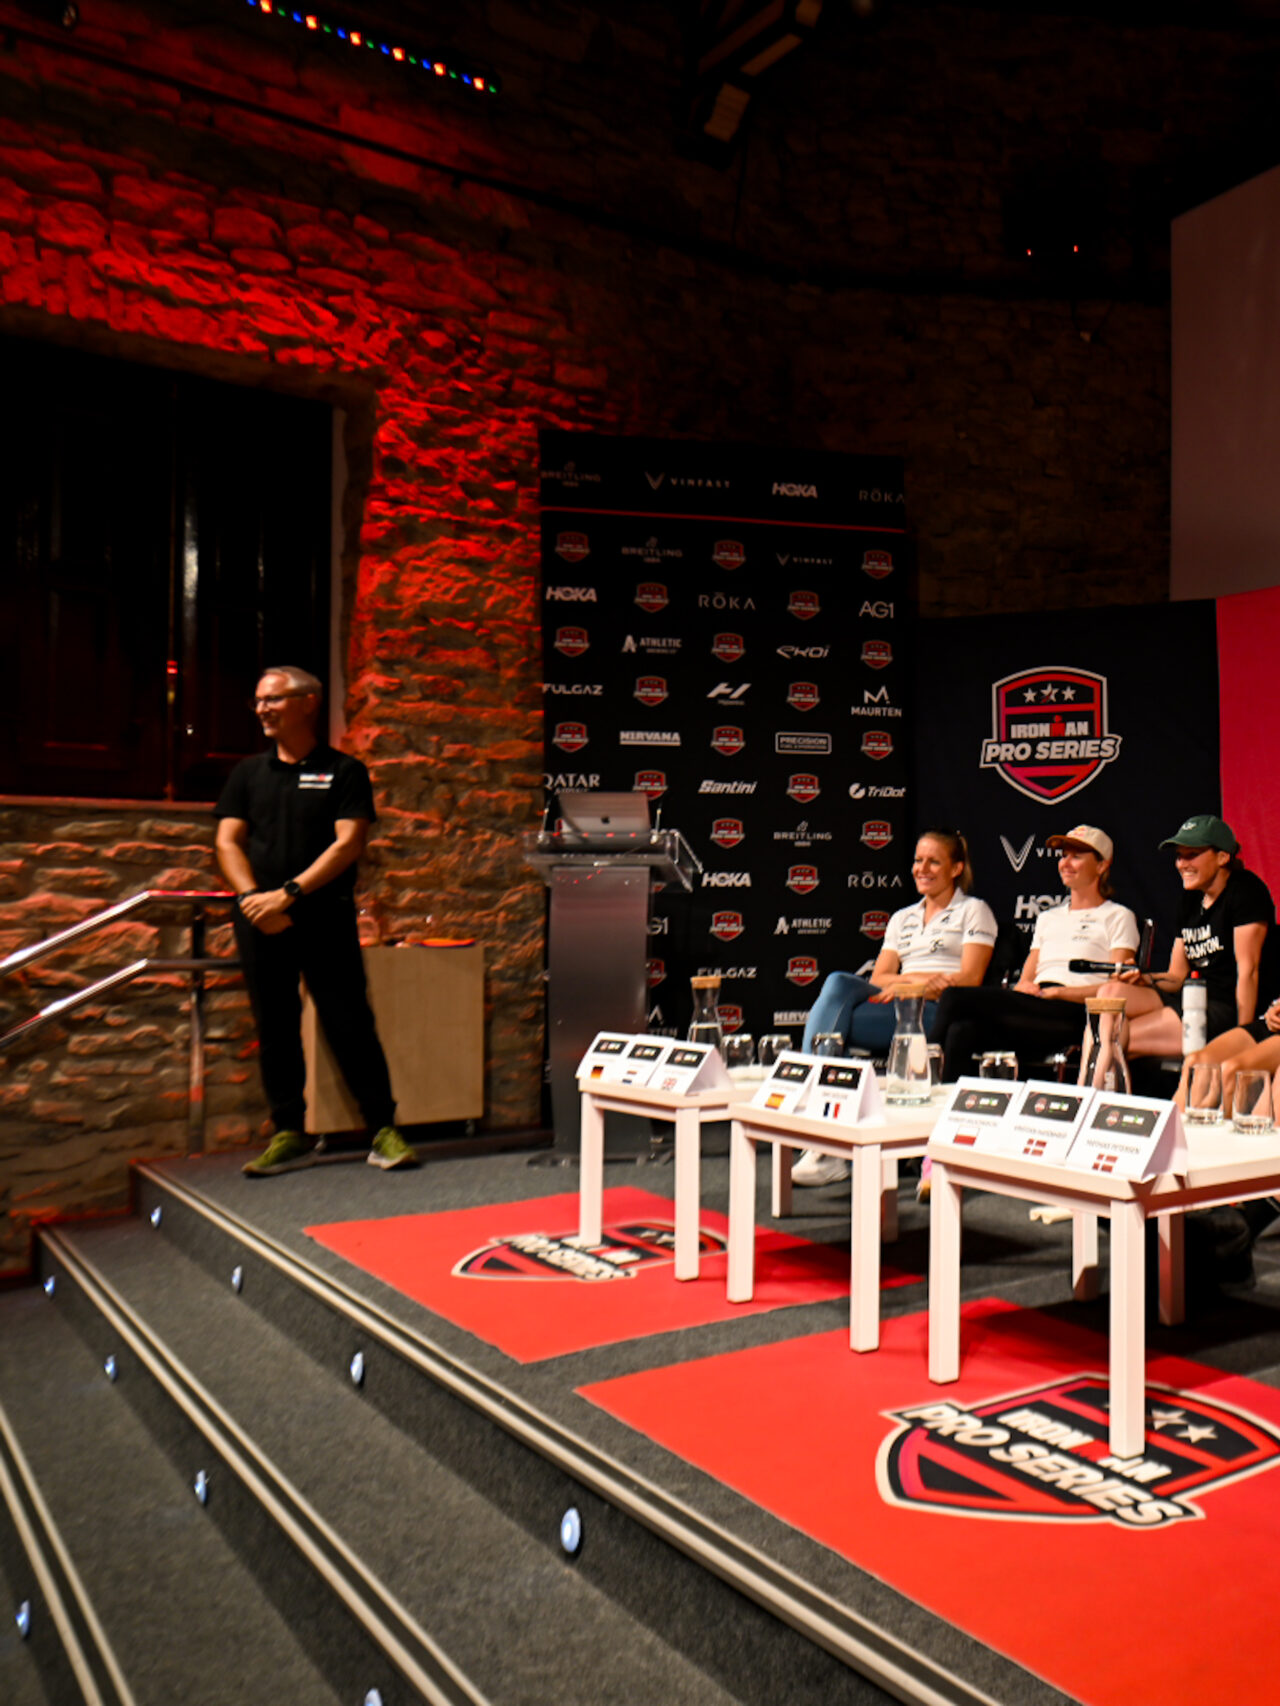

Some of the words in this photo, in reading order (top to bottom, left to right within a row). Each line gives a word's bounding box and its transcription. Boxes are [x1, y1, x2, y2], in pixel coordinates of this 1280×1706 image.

[772, 482, 817, 498] HOKA
[546, 587, 597, 602] HOKA
[859, 601, 894, 618] AG1
[851, 707, 901, 716] MAURTEN
[985, 741, 1032, 763] PRO
[1034, 738, 1117, 761] SERIES
[698, 780, 757, 794] Santini
[773, 830, 833, 843] BREITLING
[702, 872, 752, 889] HOKA
[901, 1402, 1012, 1448] PRO
[988, 1442, 1187, 1526] SERIES
